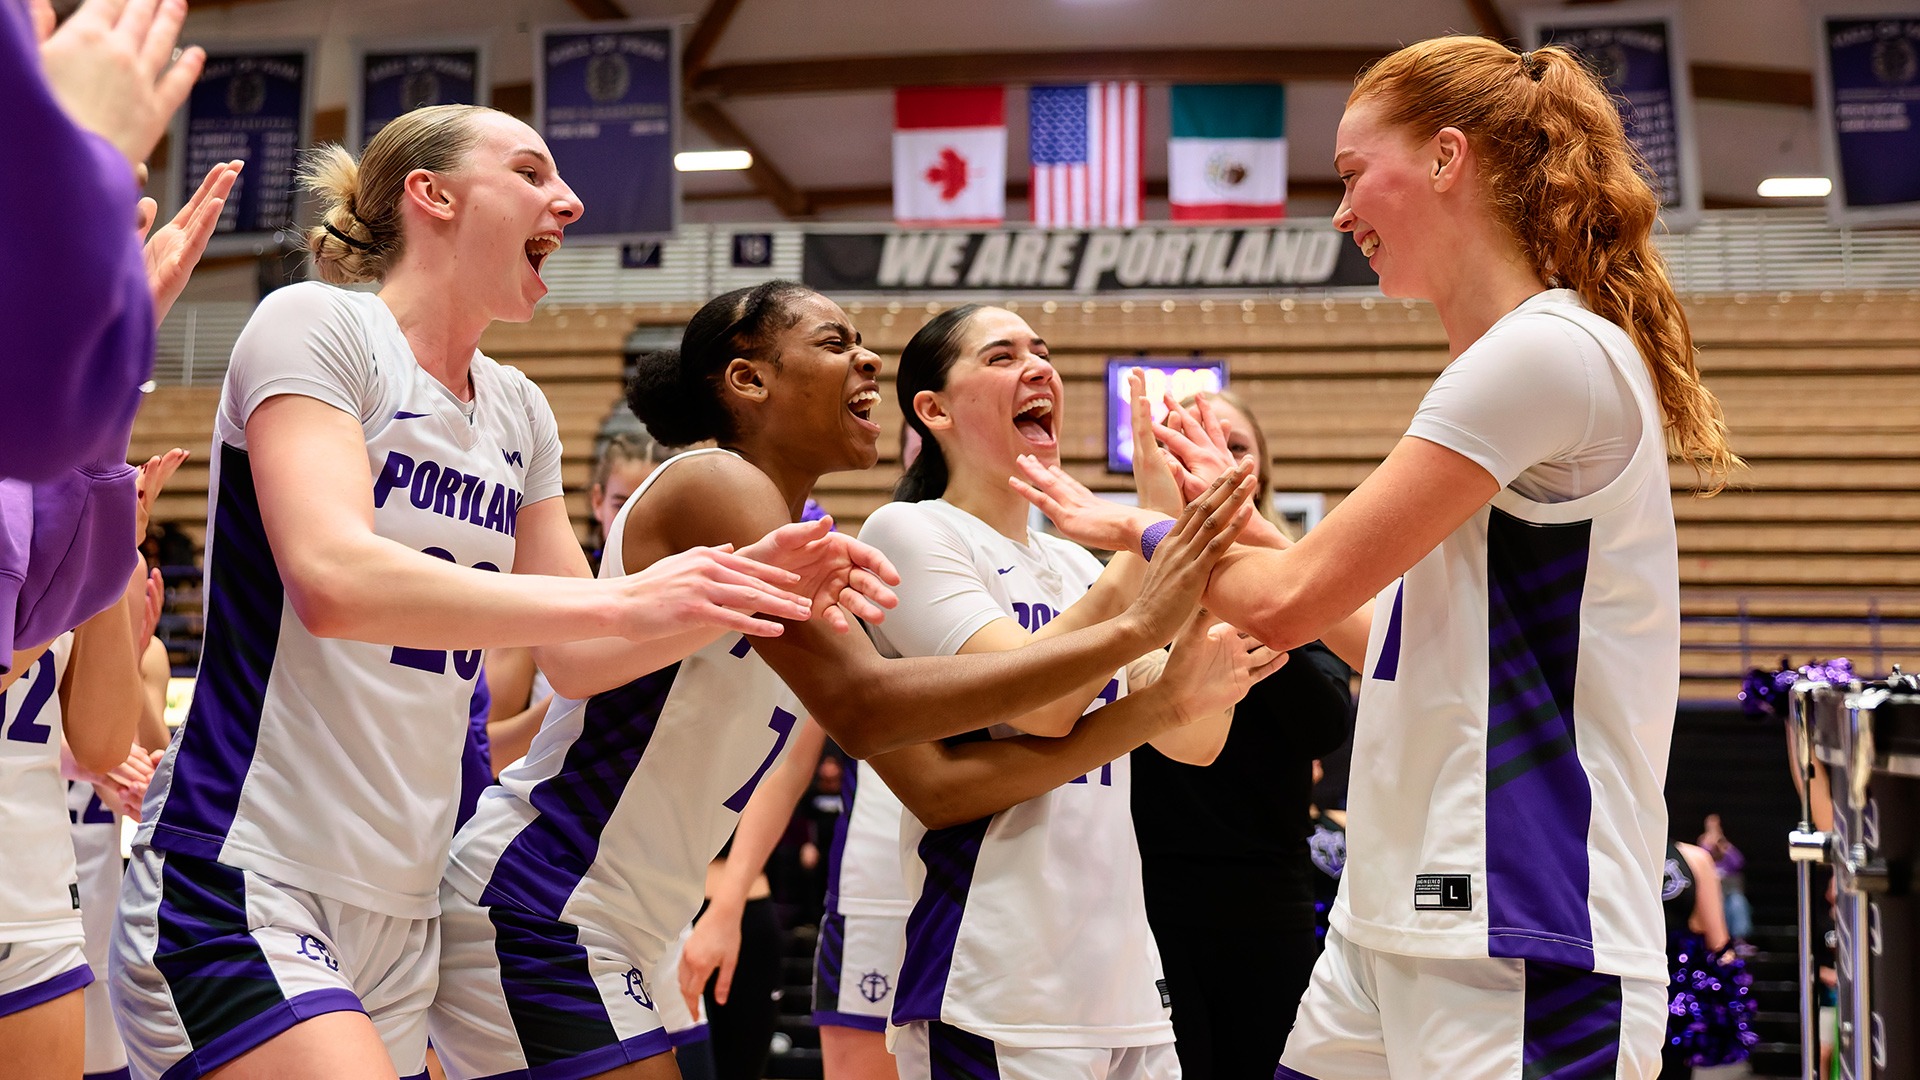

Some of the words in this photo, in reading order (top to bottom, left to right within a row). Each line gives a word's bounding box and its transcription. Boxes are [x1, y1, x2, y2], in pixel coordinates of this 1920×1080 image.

[877, 233, 971, 287] WE
[964, 233, 1081, 287] ARE
[1072, 229, 1343, 295] PORTLAND
[374, 450, 523, 538] PORTLAN
[722, 705, 797, 813] 7
[1450, 885, 1458, 900] L
